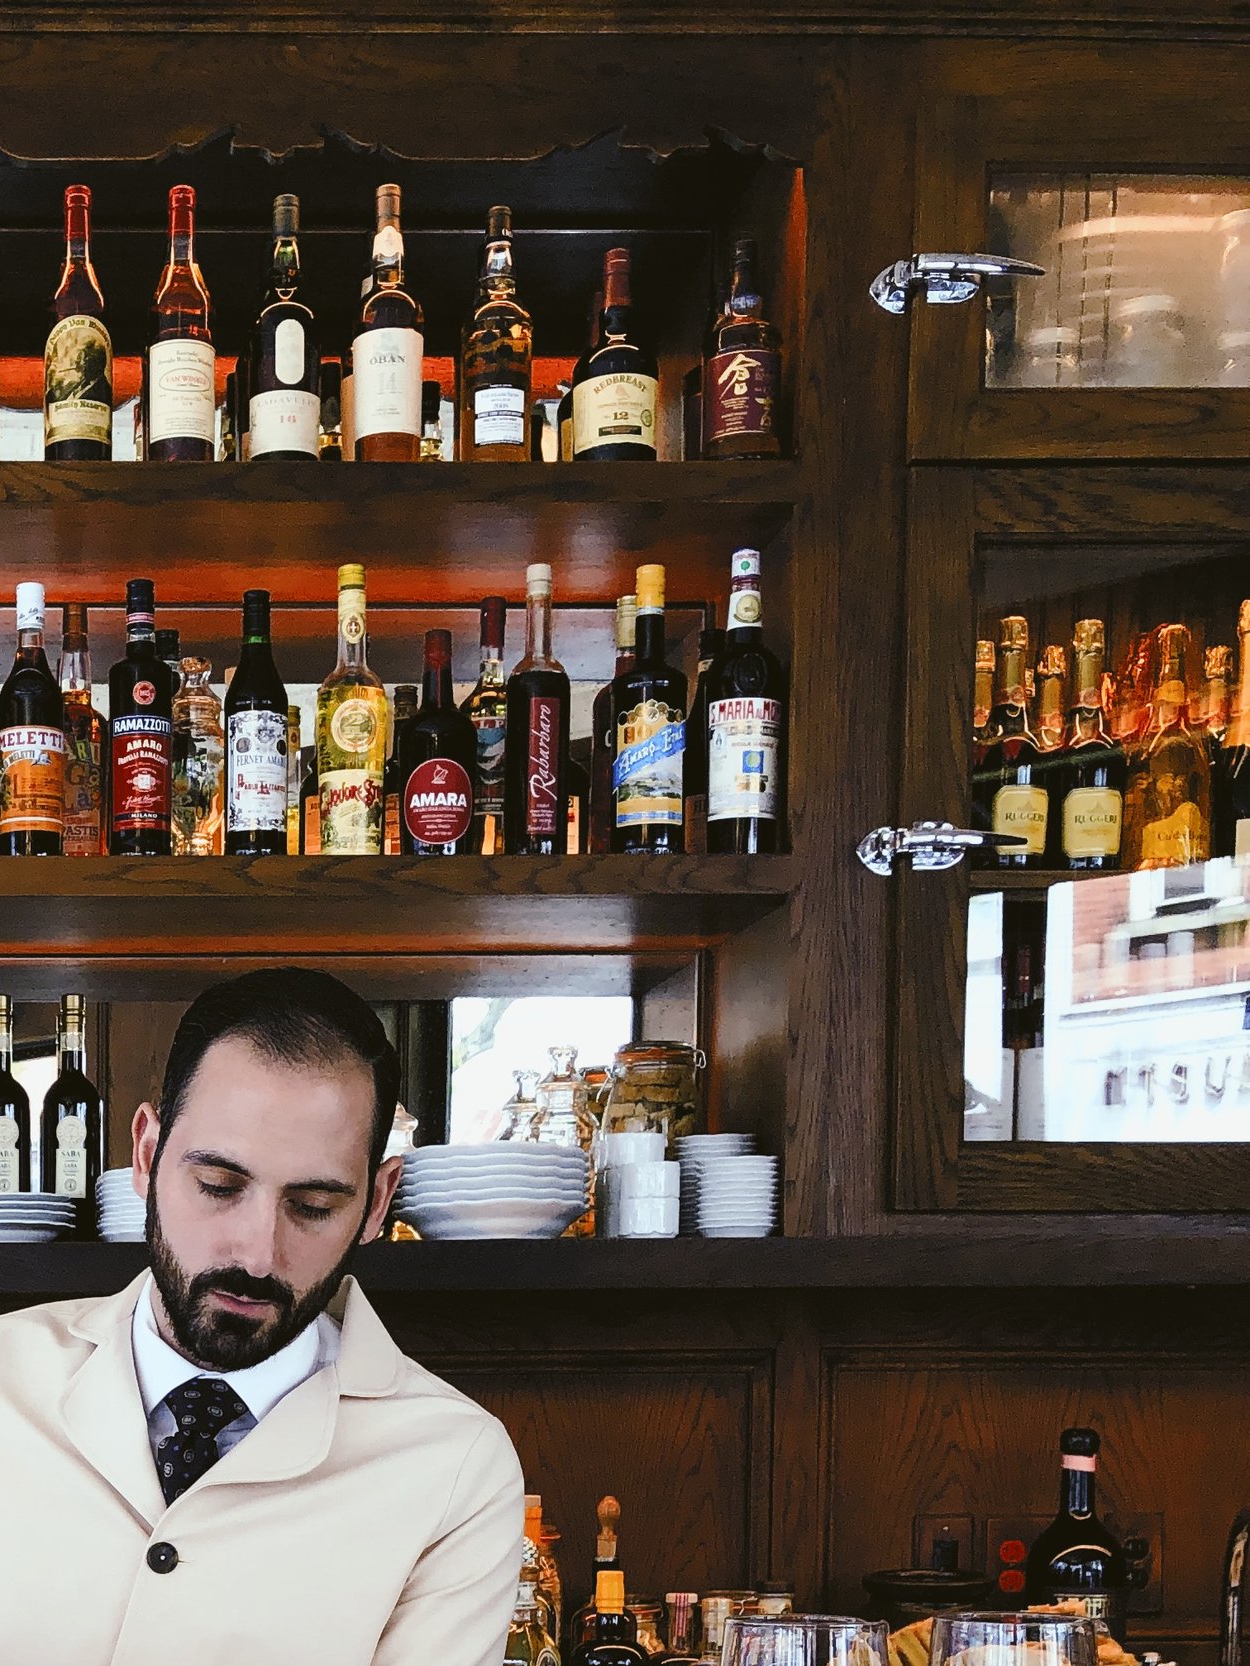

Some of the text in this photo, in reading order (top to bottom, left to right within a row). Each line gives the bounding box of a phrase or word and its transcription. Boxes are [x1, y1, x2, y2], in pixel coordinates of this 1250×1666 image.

[369, 354, 406, 366] OBAN
[593, 374, 646, 395] REDBREAST
[613, 411, 629, 421] 12
[718, 700, 754, 722] MARIA
[114, 718, 171, 734] RAMAZZOTTI
[0, 731, 62, 748] MELETTI
[126, 739, 163, 753] AMARO
[529, 704, 558, 800] Rabarbaro
[237, 755, 263, 767] FERNET
[410, 792, 468, 808] AMARA
[1005, 811, 1045, 822] RUGGERI
[1074, 814, 1118, 824] RUGGERI
